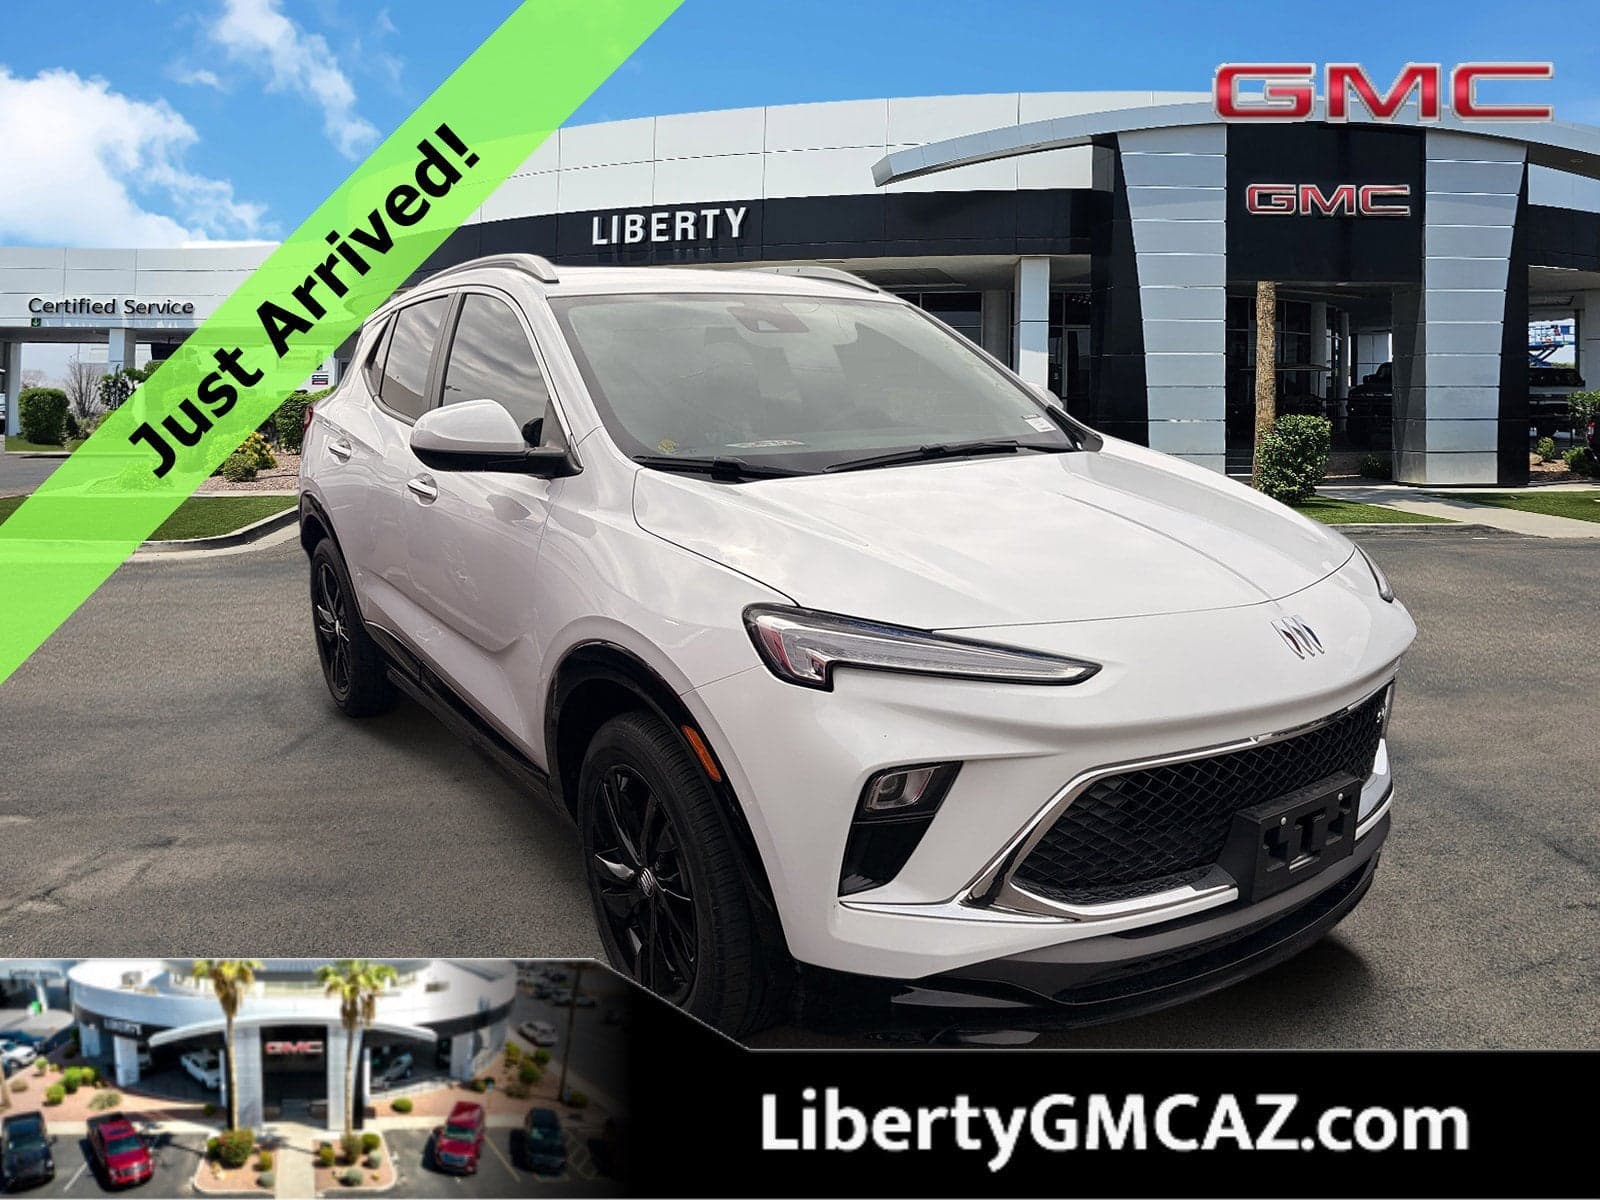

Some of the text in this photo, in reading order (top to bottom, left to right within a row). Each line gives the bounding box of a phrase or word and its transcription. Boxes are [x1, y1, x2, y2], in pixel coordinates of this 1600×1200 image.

[1246, 183, 1411, 216] GMC
[592, 207, 747, 246] LIBERTY
[28, 298, 194, 315] Certified Service
[265, 1041, 323, 1054] GMC
